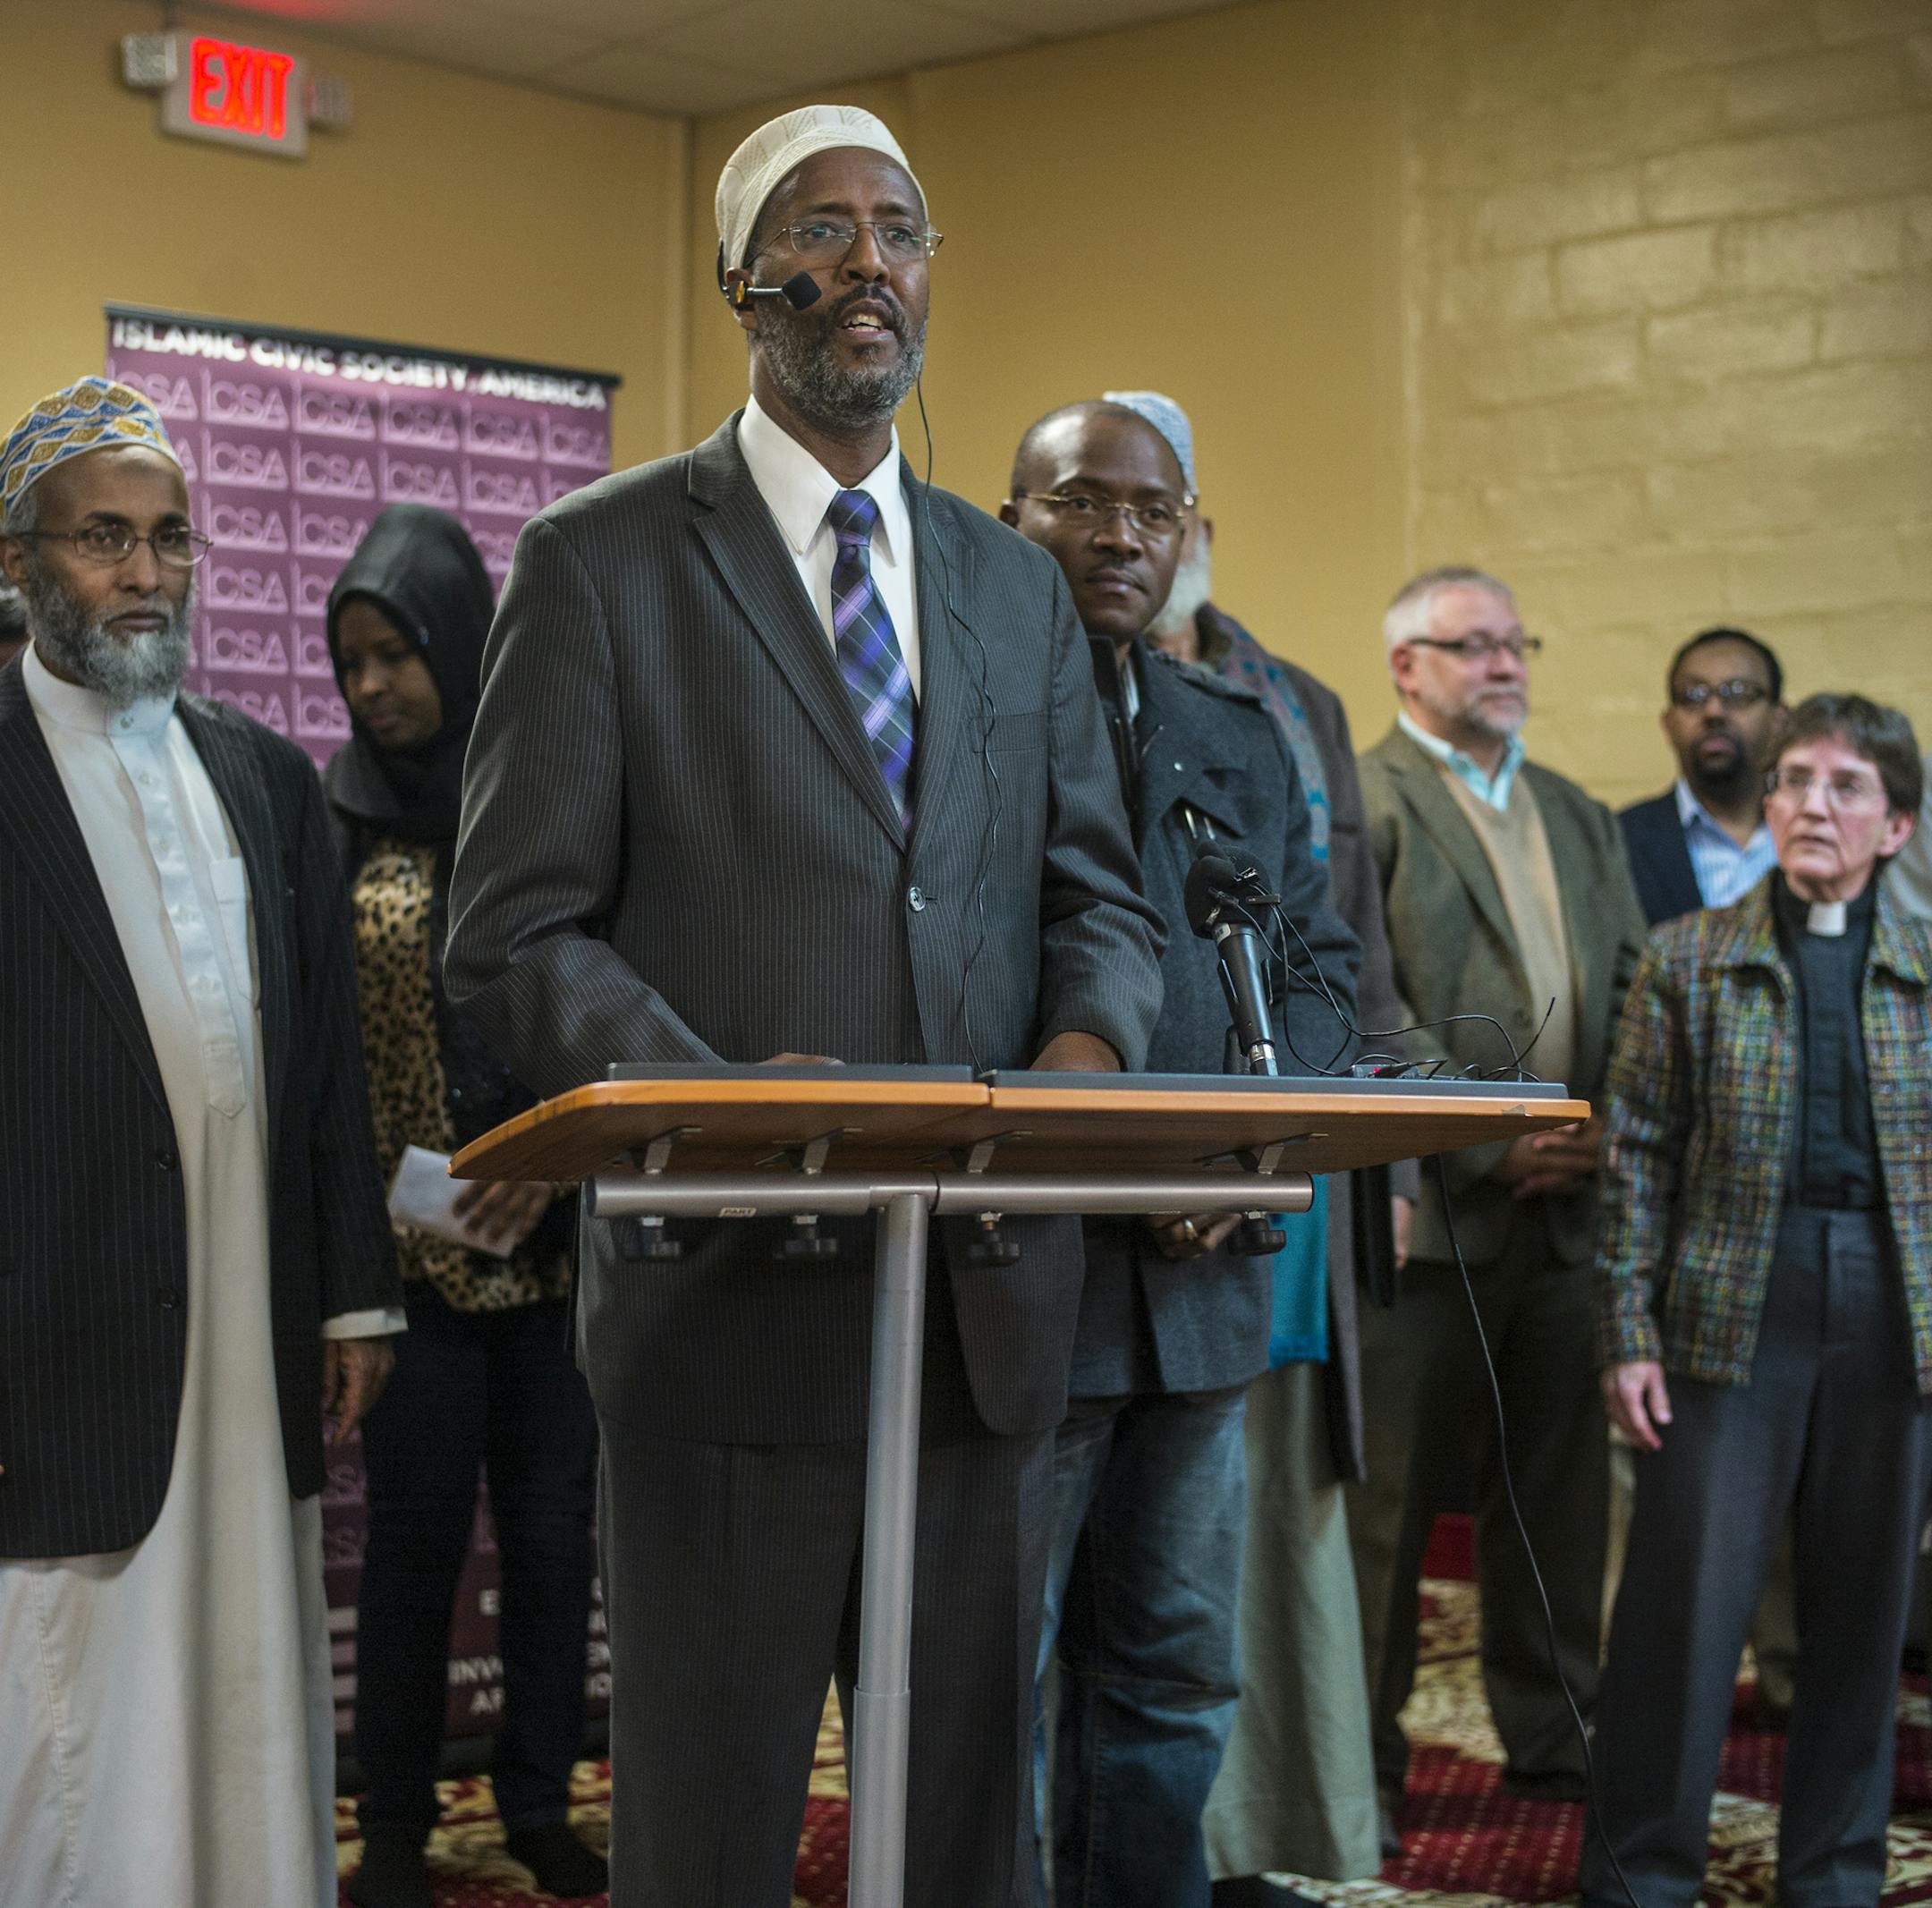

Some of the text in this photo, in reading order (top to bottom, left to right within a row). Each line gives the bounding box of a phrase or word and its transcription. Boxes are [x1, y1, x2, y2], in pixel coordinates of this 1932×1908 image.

[190, 37, 294, 140] EXIT
[112, 319, 247, 361] ISLAMIC
[250, 337, 336, 377] CIVIC
[339, 351, 469, 392] SOCIETY
[479, 367, 606, 411] AMERICA
